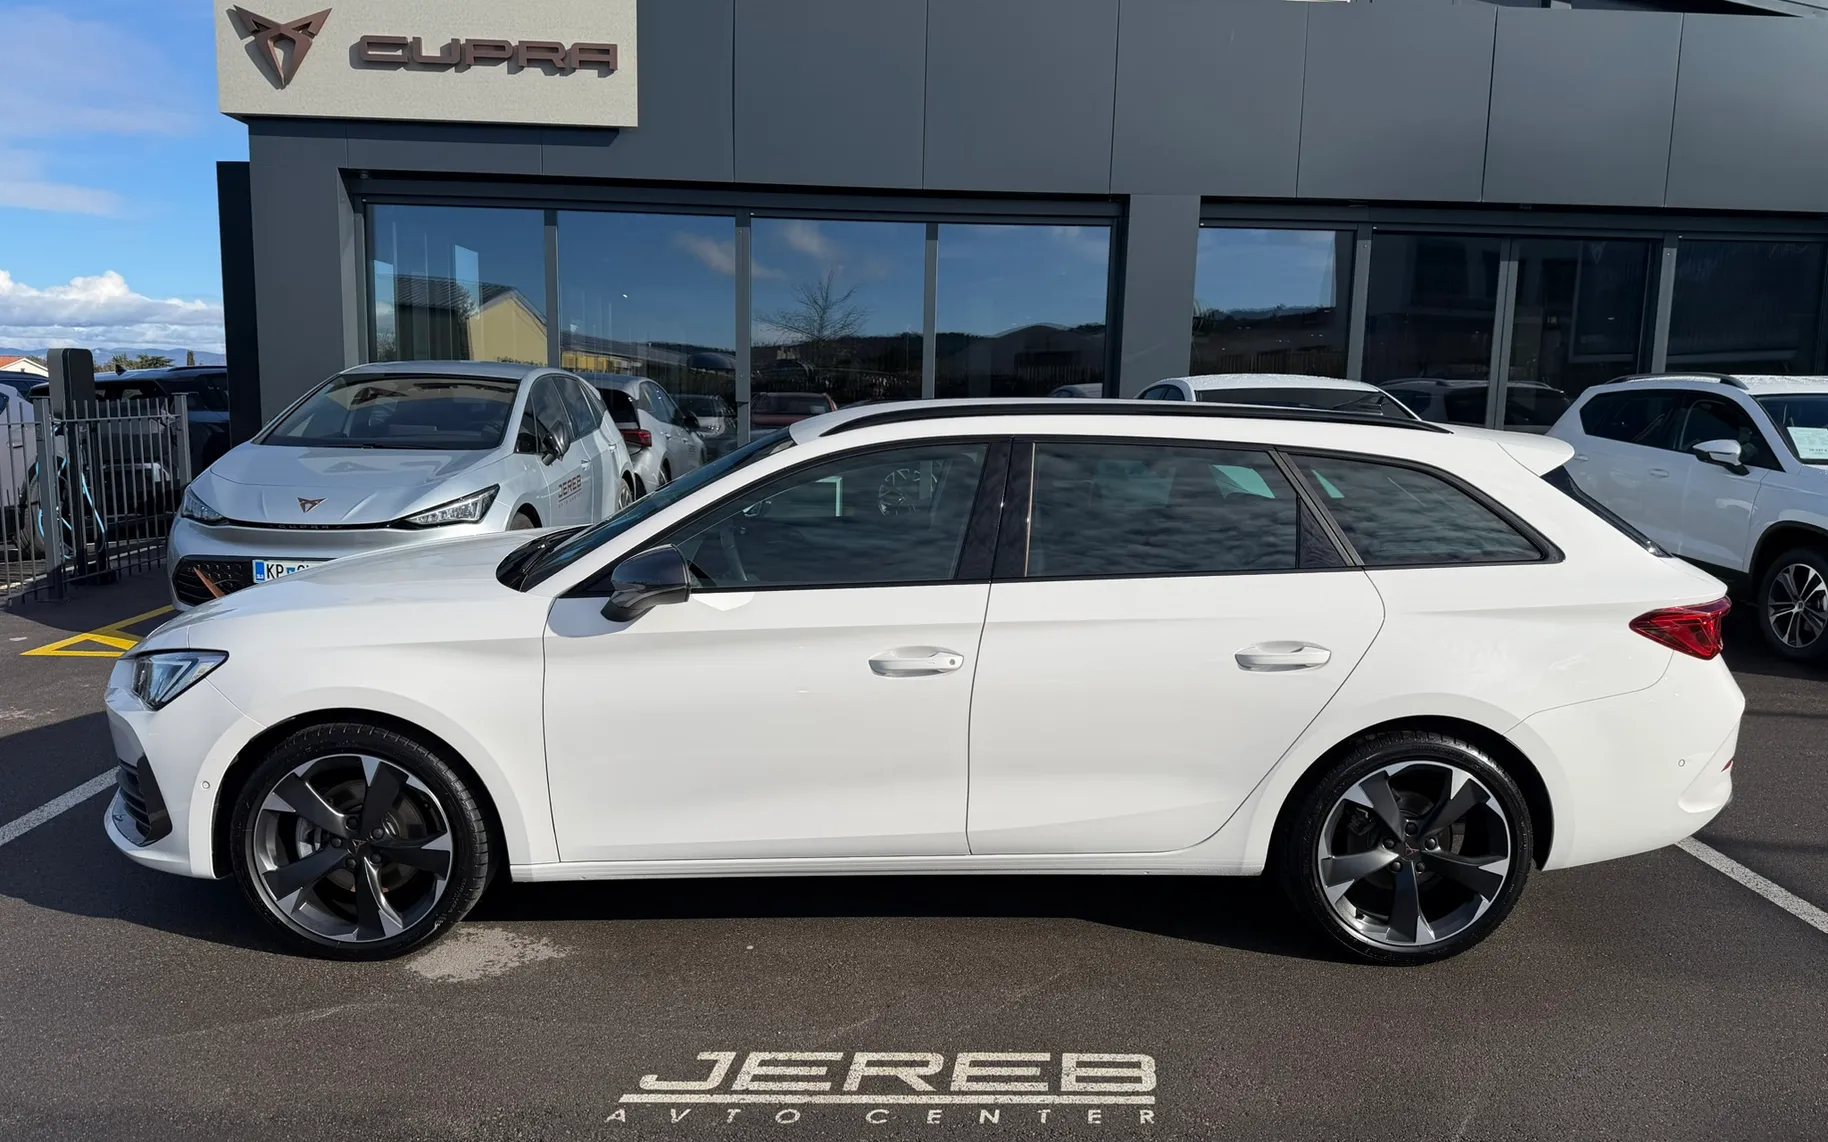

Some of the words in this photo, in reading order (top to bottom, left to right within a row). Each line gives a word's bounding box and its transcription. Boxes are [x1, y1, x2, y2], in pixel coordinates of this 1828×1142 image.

[359, 35, 619, 71] CUPRA
[558, 474, 582, 498] JEREB
[266, 564, 284, 579] KP
[639, 1051, 1157, 1091] JEREB
[604, 1108, 801, 1124] AVTO
[865, 1108, 1156, 1125] CENTER
